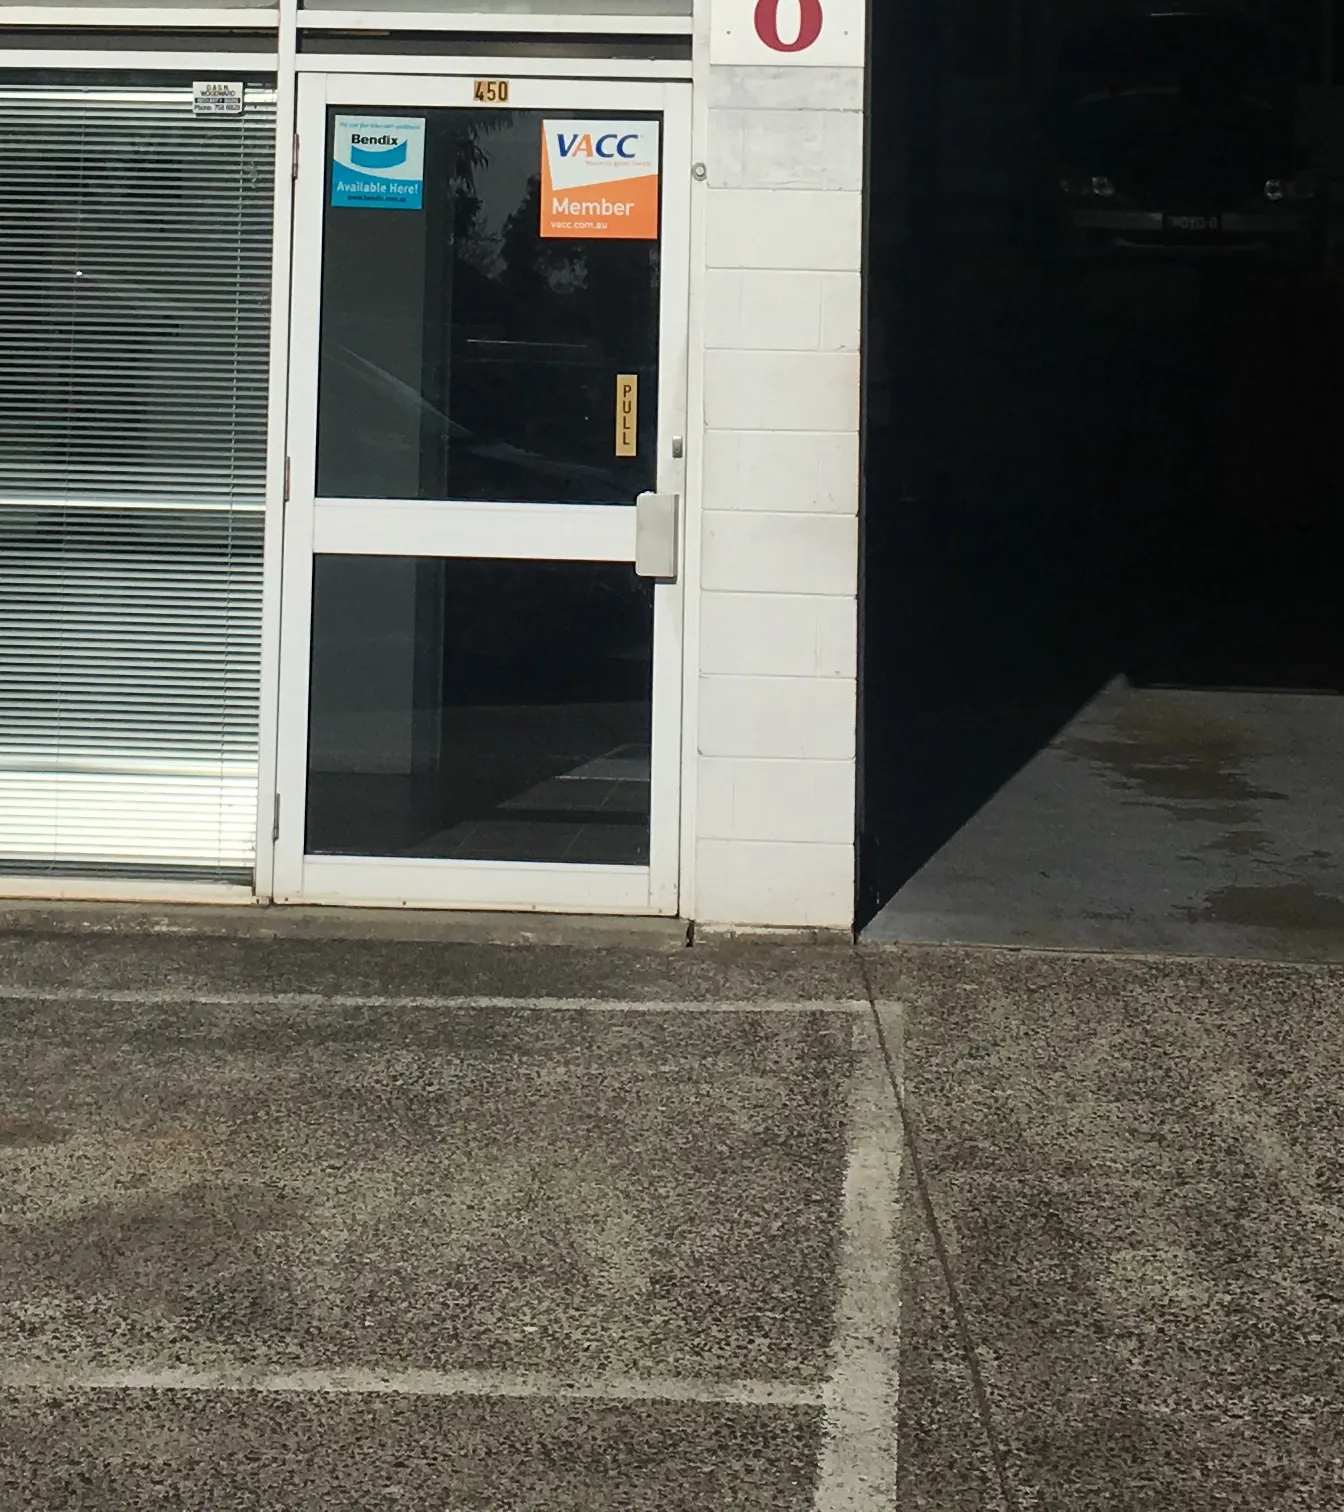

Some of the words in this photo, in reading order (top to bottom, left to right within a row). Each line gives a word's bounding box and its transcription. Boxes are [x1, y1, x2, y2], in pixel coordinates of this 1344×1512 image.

[475, 81, 508, 102] 450
[351, 133, 398, 145] Bendix
[557, 133, 638, 158] VACC
[336, 181, 387, 193] Available
[390, 183, 418, 194] Here!
[552, 197, 635, 216] Member
[622, 384, 632, 446] PULL
